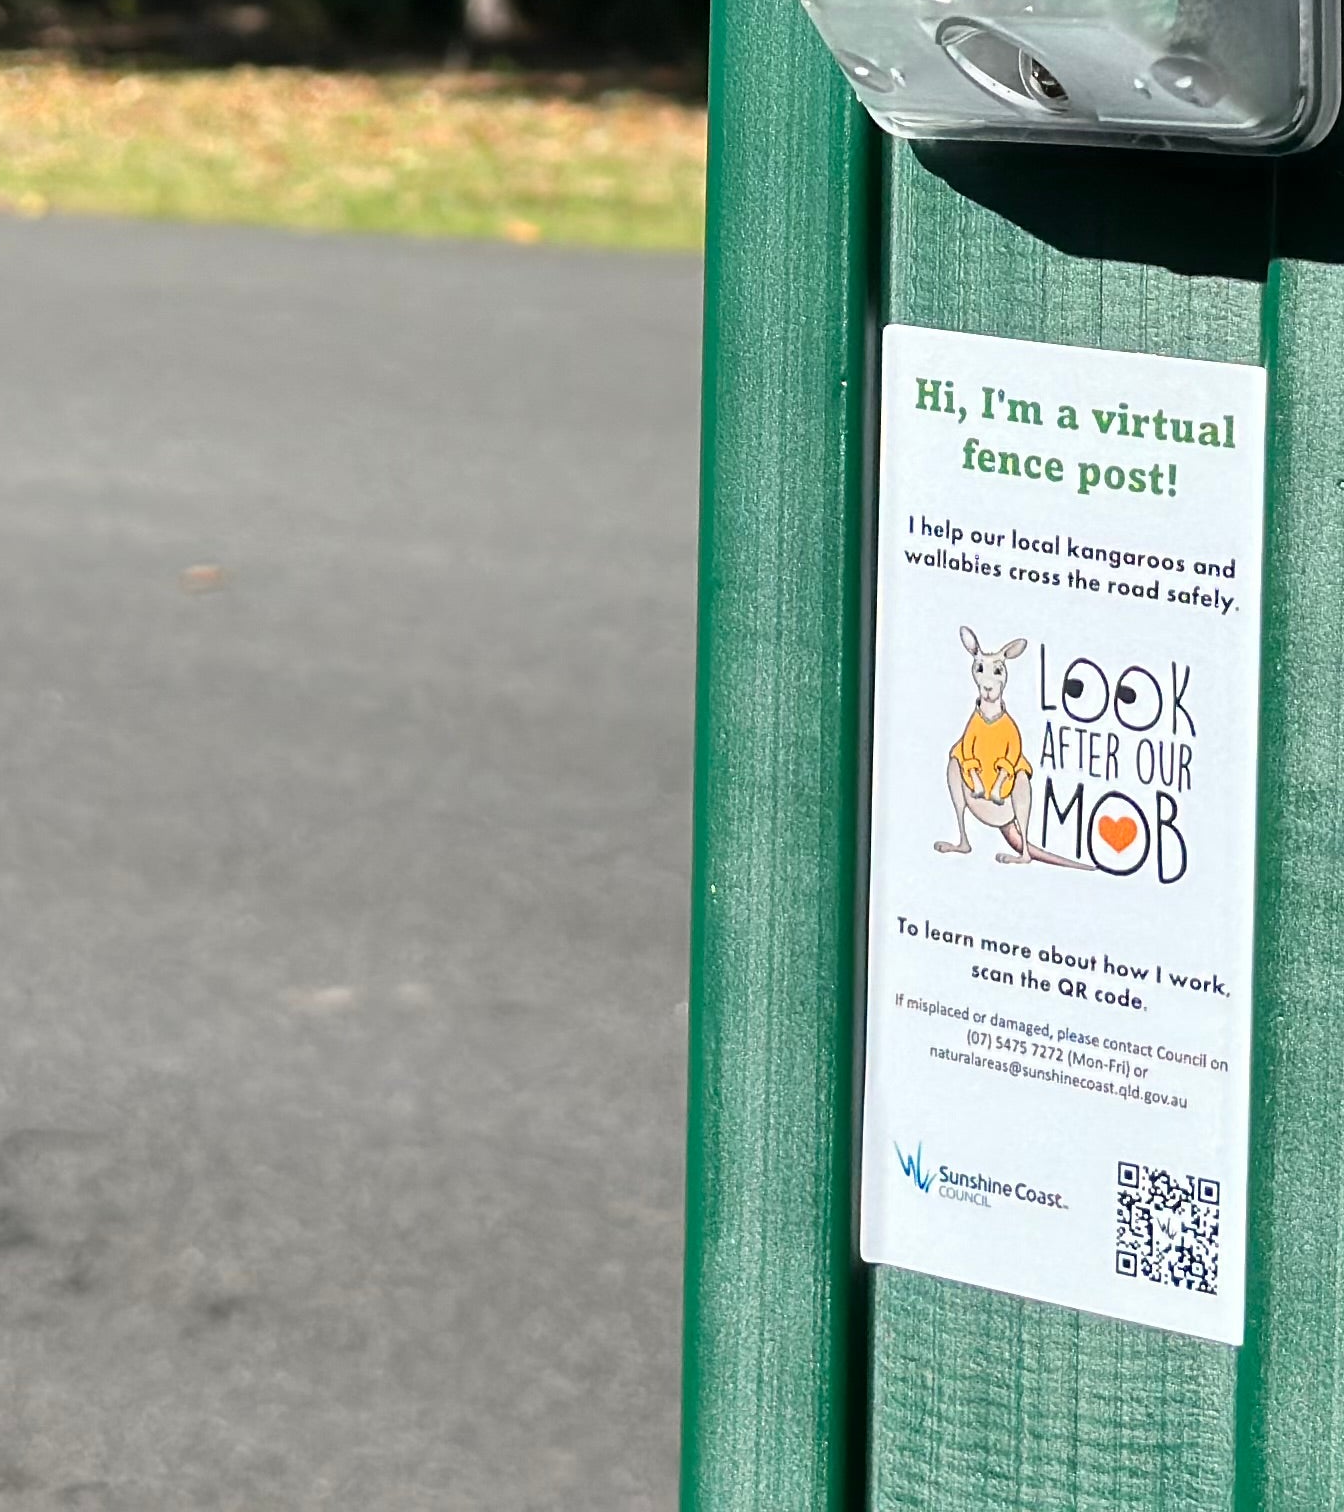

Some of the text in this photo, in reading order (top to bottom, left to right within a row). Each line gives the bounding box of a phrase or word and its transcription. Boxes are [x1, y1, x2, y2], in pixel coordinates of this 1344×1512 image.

[915, 377, 1236, 448] Hi, I'm a virtual
[962, 438, 1177, 497] fence post!
[909, 515, 1236, 579] I help our local kangaroos and
[904, 547, 1240, 615] wallabies cross the road safely.
[1040, 643, 1196, 736] LOOK
[1040, 721, 1192, 792] AFTER OUR
[1042, 778, 1187, 884] MOB
[897, 916, 918, 936] To
[925, 920, 974, 947] learn
[981, 938, 1031, 958] more
[1038, 945, 1096, 971] about
[1104, 954, 1149, 980] how
[1156, 966, 1161, 983] I
[972, 965, 1148, 1011] scan the QR code.
[895, 993, 1228, 1072] If misplaced or damaged, please contact Council on
[967, 1030, 1148, 1079] (07) 5475 7272 (Mon-Fri) or
[930, 1044, 1188, 1108] naturalareas@sunshinecoast.qld.gov.au
[939, 1166, 1012, 1197] Sunshine
[939, 1186, 992, 1208] COUNCIL
